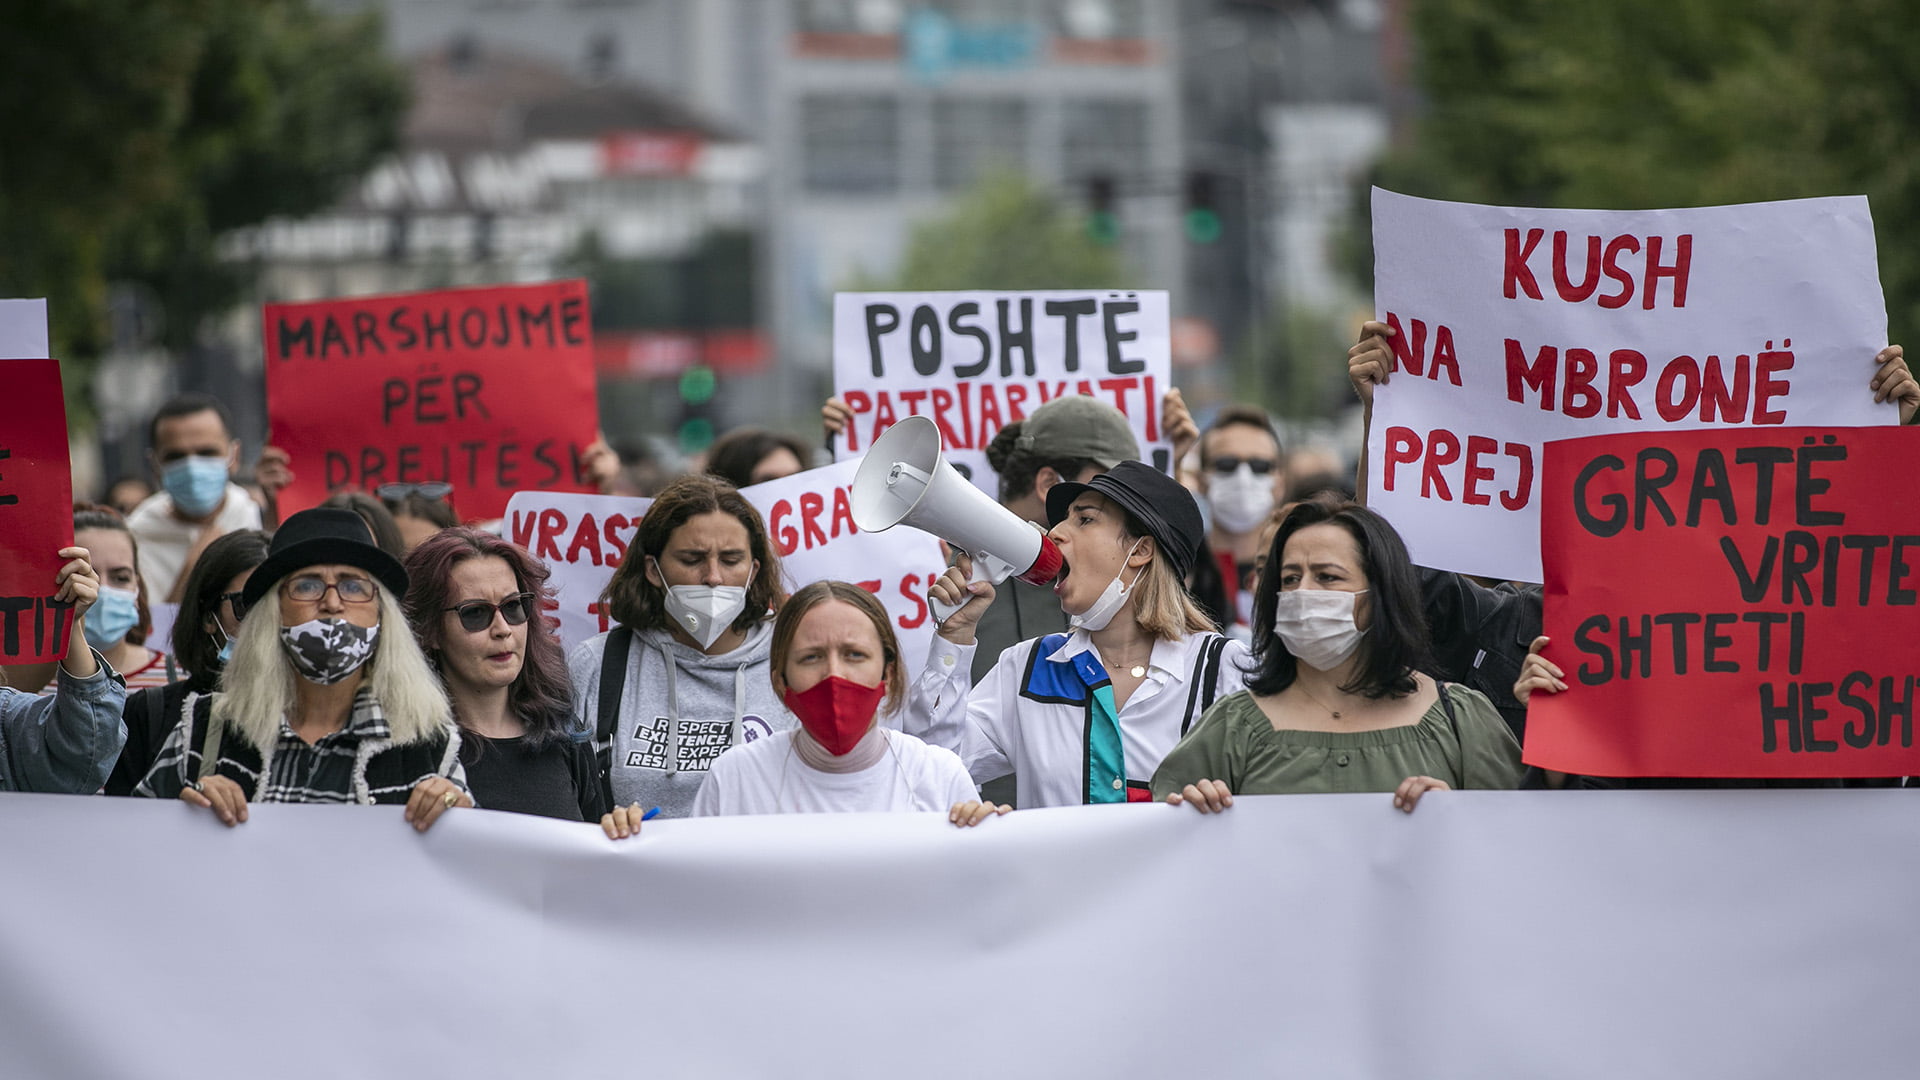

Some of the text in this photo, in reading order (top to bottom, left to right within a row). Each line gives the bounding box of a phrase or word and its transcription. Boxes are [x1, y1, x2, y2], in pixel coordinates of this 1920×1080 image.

[1503, 228, 1693, 310] KUSH
[865, 292, 1146, 377] POSHTË
[1386, 311, 1795, 425] NA MBRONË
[382, 364, 491, 427] PËR
[1383, 426, 1534, 511] PREJ
[1573, 435, 1848, 538] GRATË
[512, 508, 644, 569] VRAS
[769, 485, 859, 557] GRA
[1720, 531, 1920, 607] VRITE
[1573, 612, 1805, 686] SHTETI
[638, 727, 728, 747] EXITENCE
[657, 720, 730, 734] RSPECT
[1759, 671, 1920, 753] HESH
[677, 745, 730, 758] EXPEC
